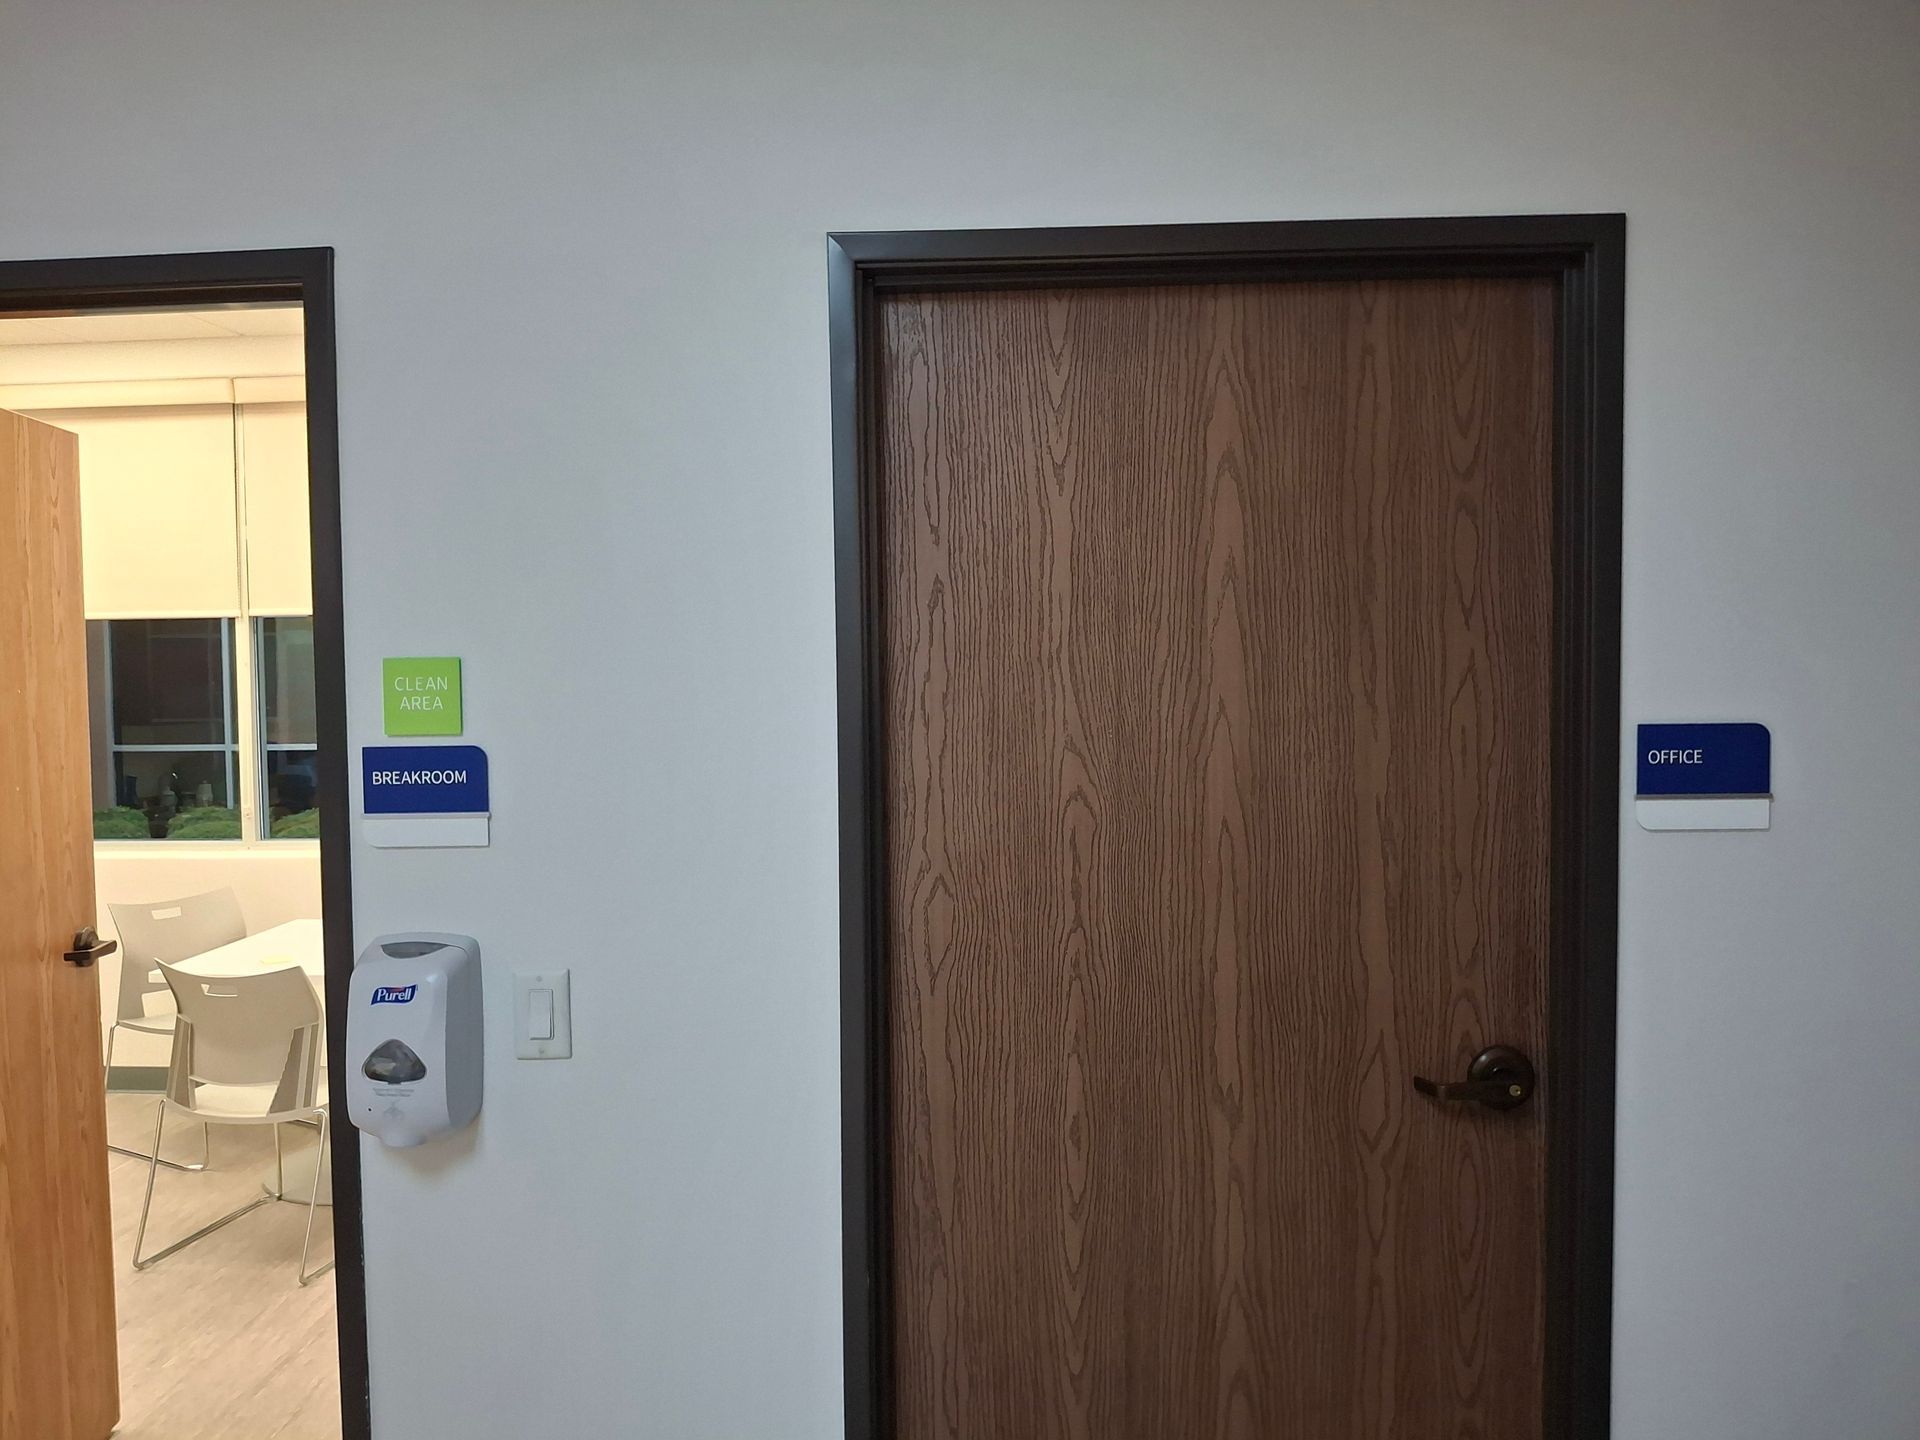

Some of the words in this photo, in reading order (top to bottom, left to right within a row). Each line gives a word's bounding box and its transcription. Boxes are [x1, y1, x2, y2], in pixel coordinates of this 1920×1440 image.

[394, 677, 449, 691] CLEAN
[399, 696, 444, 711] AREA
[1647, 749, 1704, 765] OFFICE
[372, 770, 467, 785] BREAKROOM
[376, 988, 412, 1002] Purell
